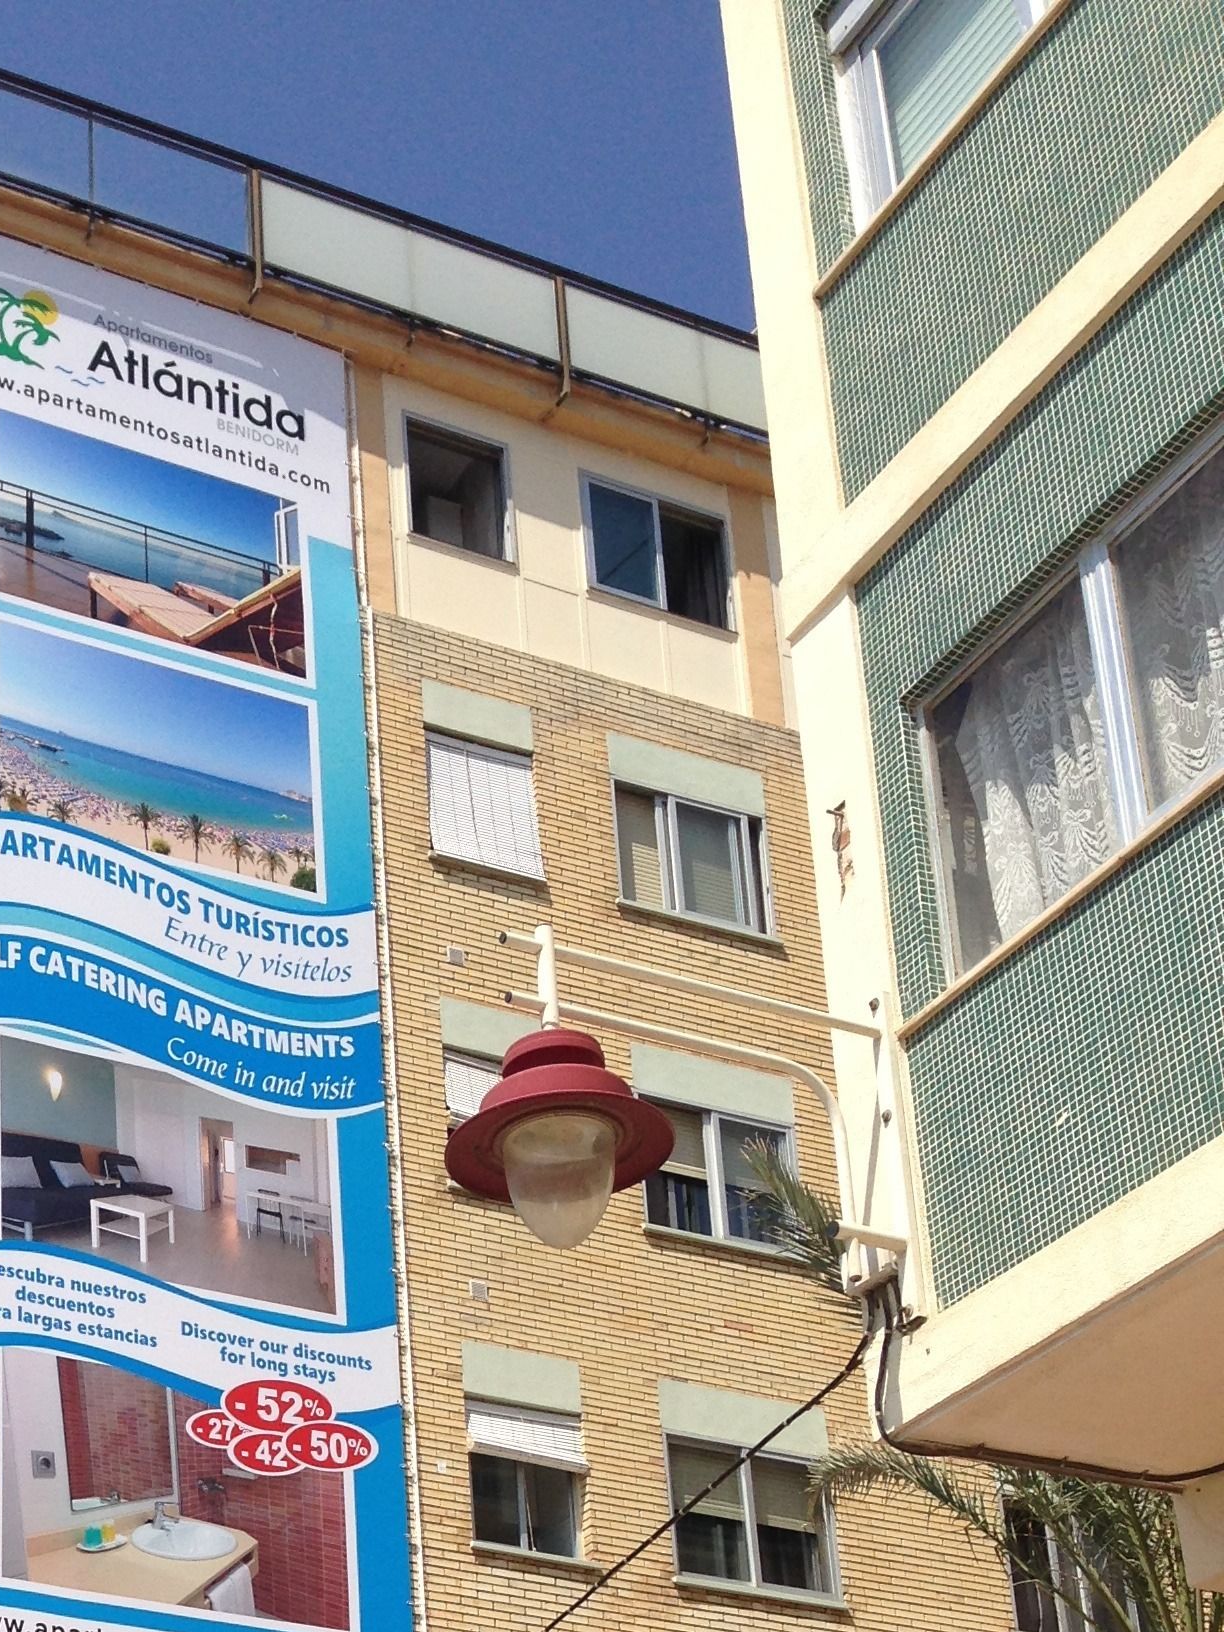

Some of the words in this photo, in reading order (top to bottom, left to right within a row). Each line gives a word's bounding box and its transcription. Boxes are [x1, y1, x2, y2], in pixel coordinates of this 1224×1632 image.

[93, 313, 214, 365] Apartamentos
[87, 340, 306, 441] Atlántida
[216, 418, 299, 456] BENIDORM
[164, 916, 228, 962] Entre
[237, 951, 253, 977] y
[260, 955, 352, 983] visítelos
[28, 946, 167, 1018] CATERING
[175, 998, 356, 1058] APARTMENTS
[167, 1037, 228, 1080] Come
[234, 1060, 255, 1088] in
[262, 1073, 304, 1097] and
[310, 1075, 356, 1100] visit
[15, 1285, 115, 1319] descuentos
[71, 1278, 147, 1304] nuestros
[17, 1306, 72, 1333] largas
[77, 1321, 158, 1348] estancias
[181, 1321, 254, 1350] Discover
[259, 1336, 288, 1355] our
[293, 1342, 373, 1371] discounts
[220, 1346, 246, 1366] for
[251, 1353, 288, 1377] long
[293, 1361, 336, 1384] stays
